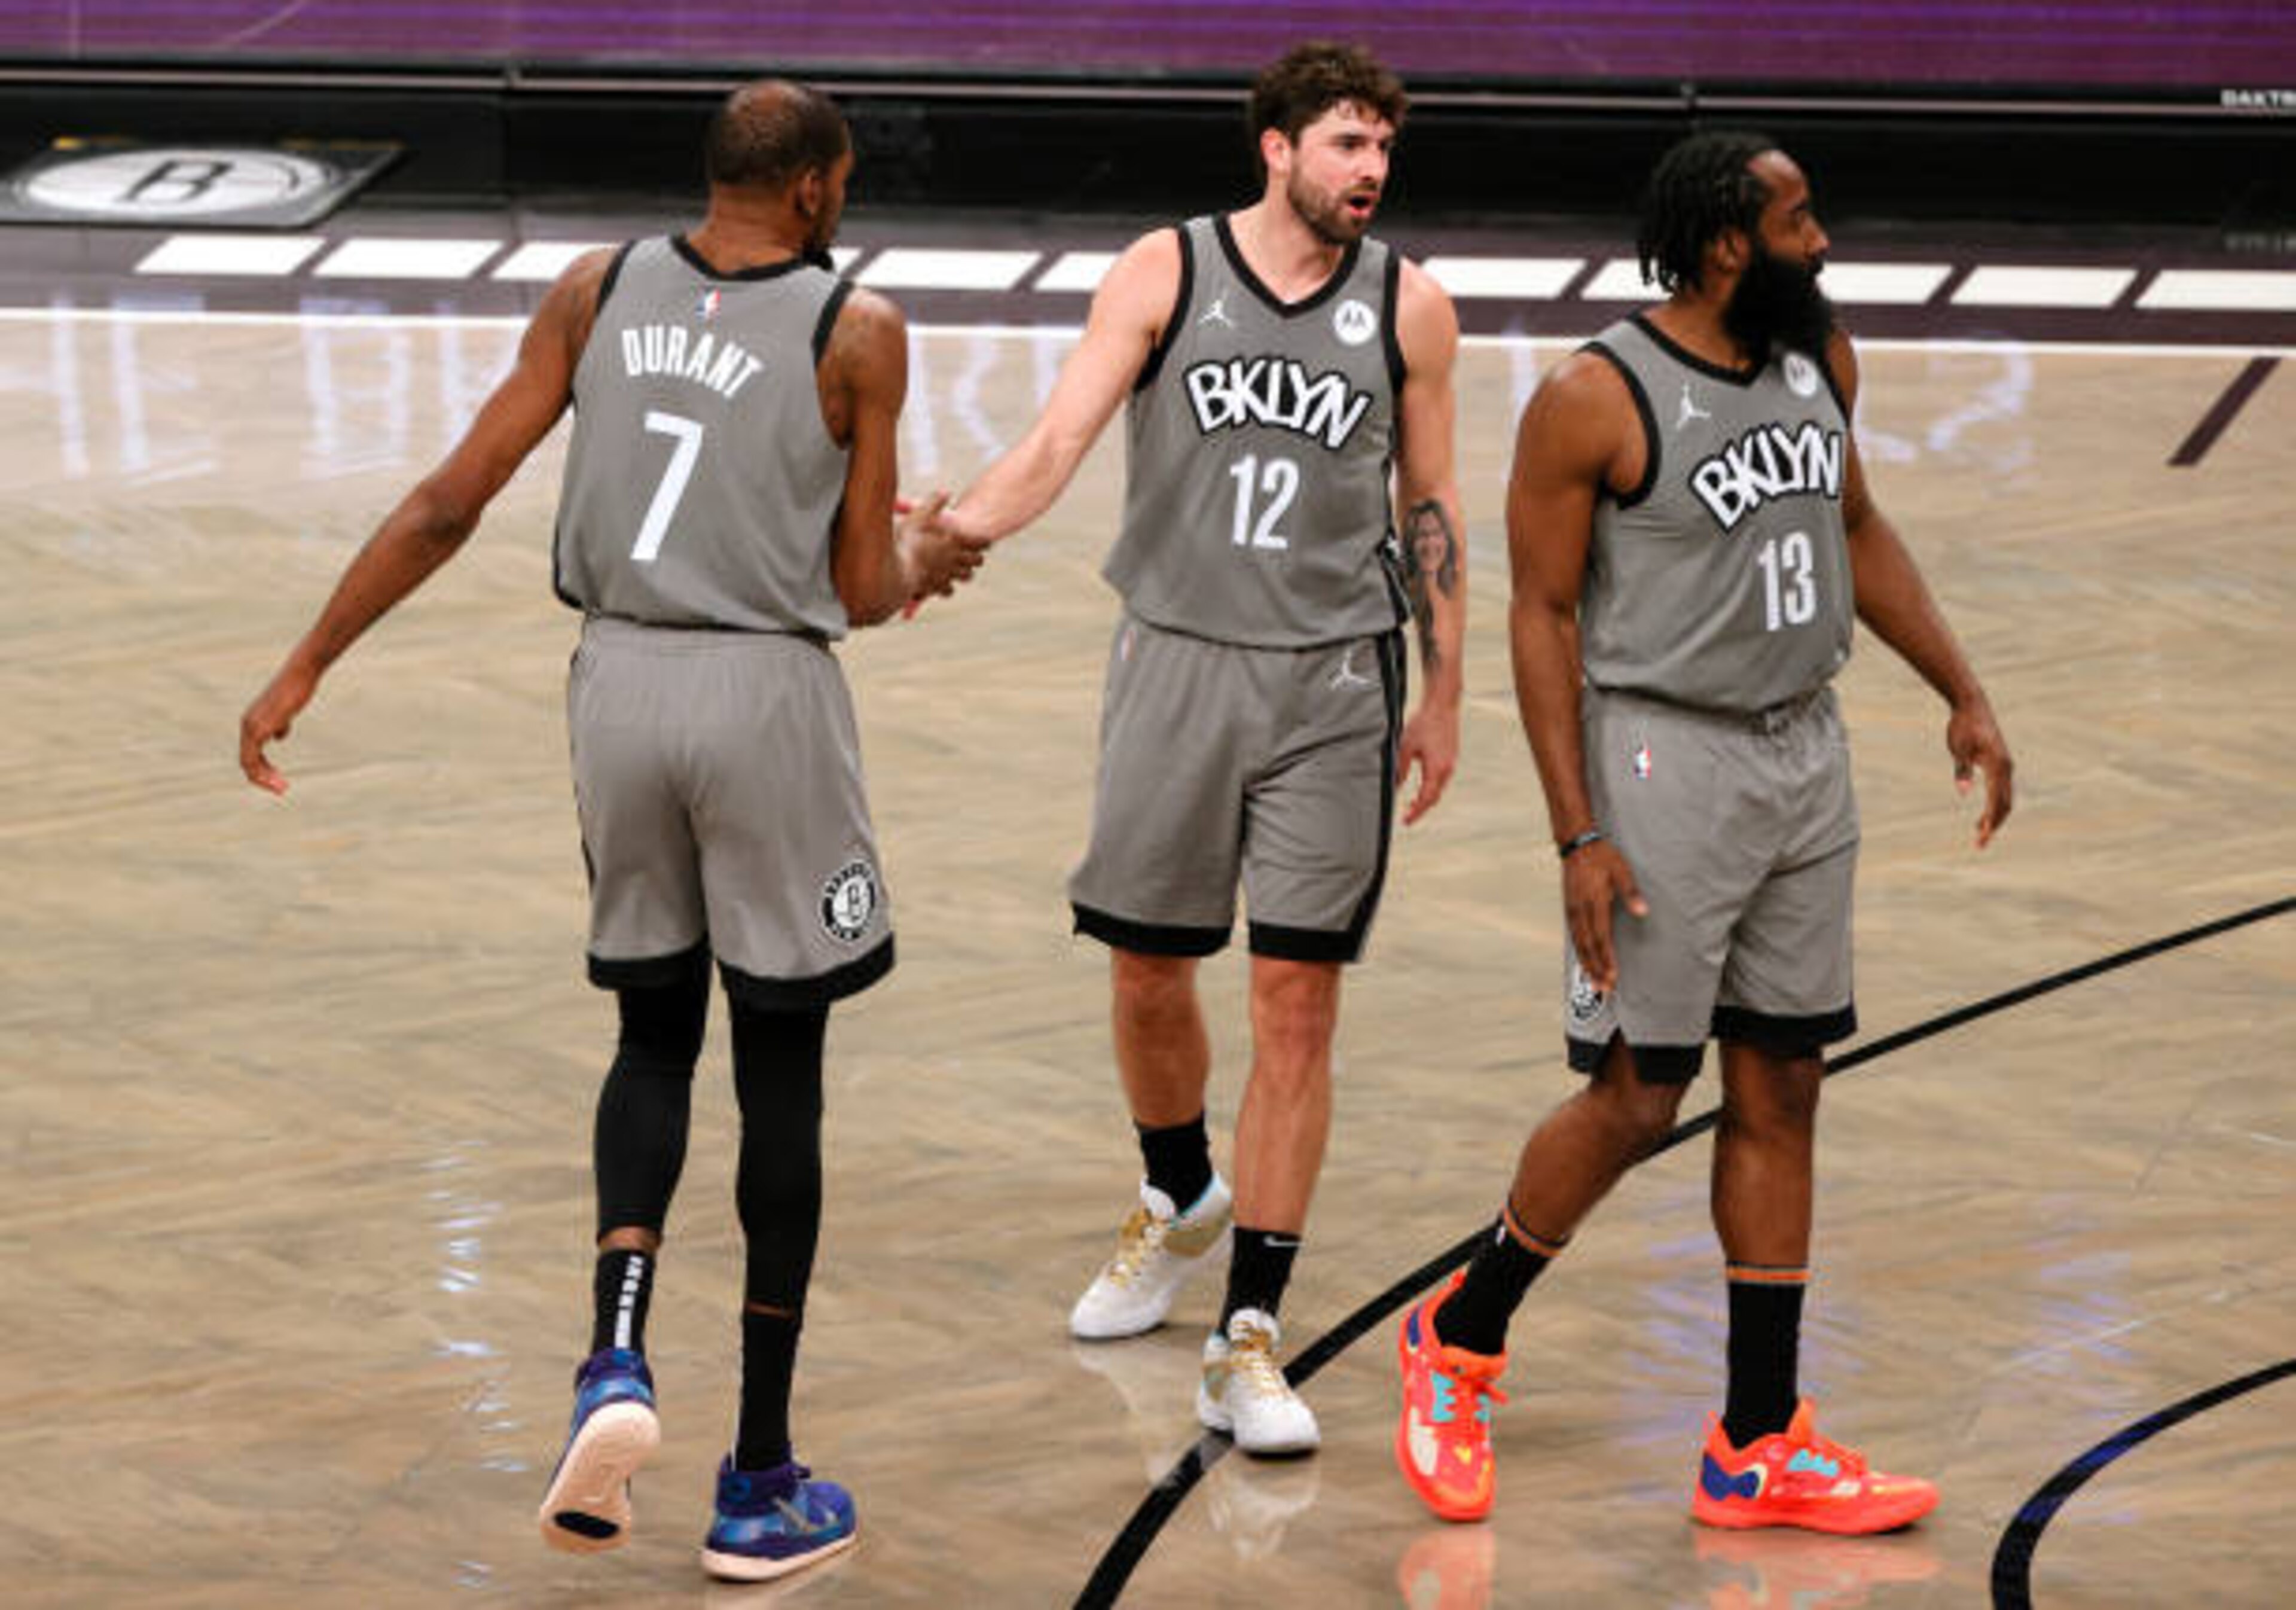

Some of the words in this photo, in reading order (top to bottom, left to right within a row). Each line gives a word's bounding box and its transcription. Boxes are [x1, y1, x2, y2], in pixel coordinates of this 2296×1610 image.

[622, 325, 764, 398] DURANT
[1183, 356, 1373, 451] BKLYN
[630, 411, 704, 560] 7
[1230, 454, 1300, 550] 12
[1690, 420, 1842, 533] BKLYN
[1757, 531, 1816, 632] 13
